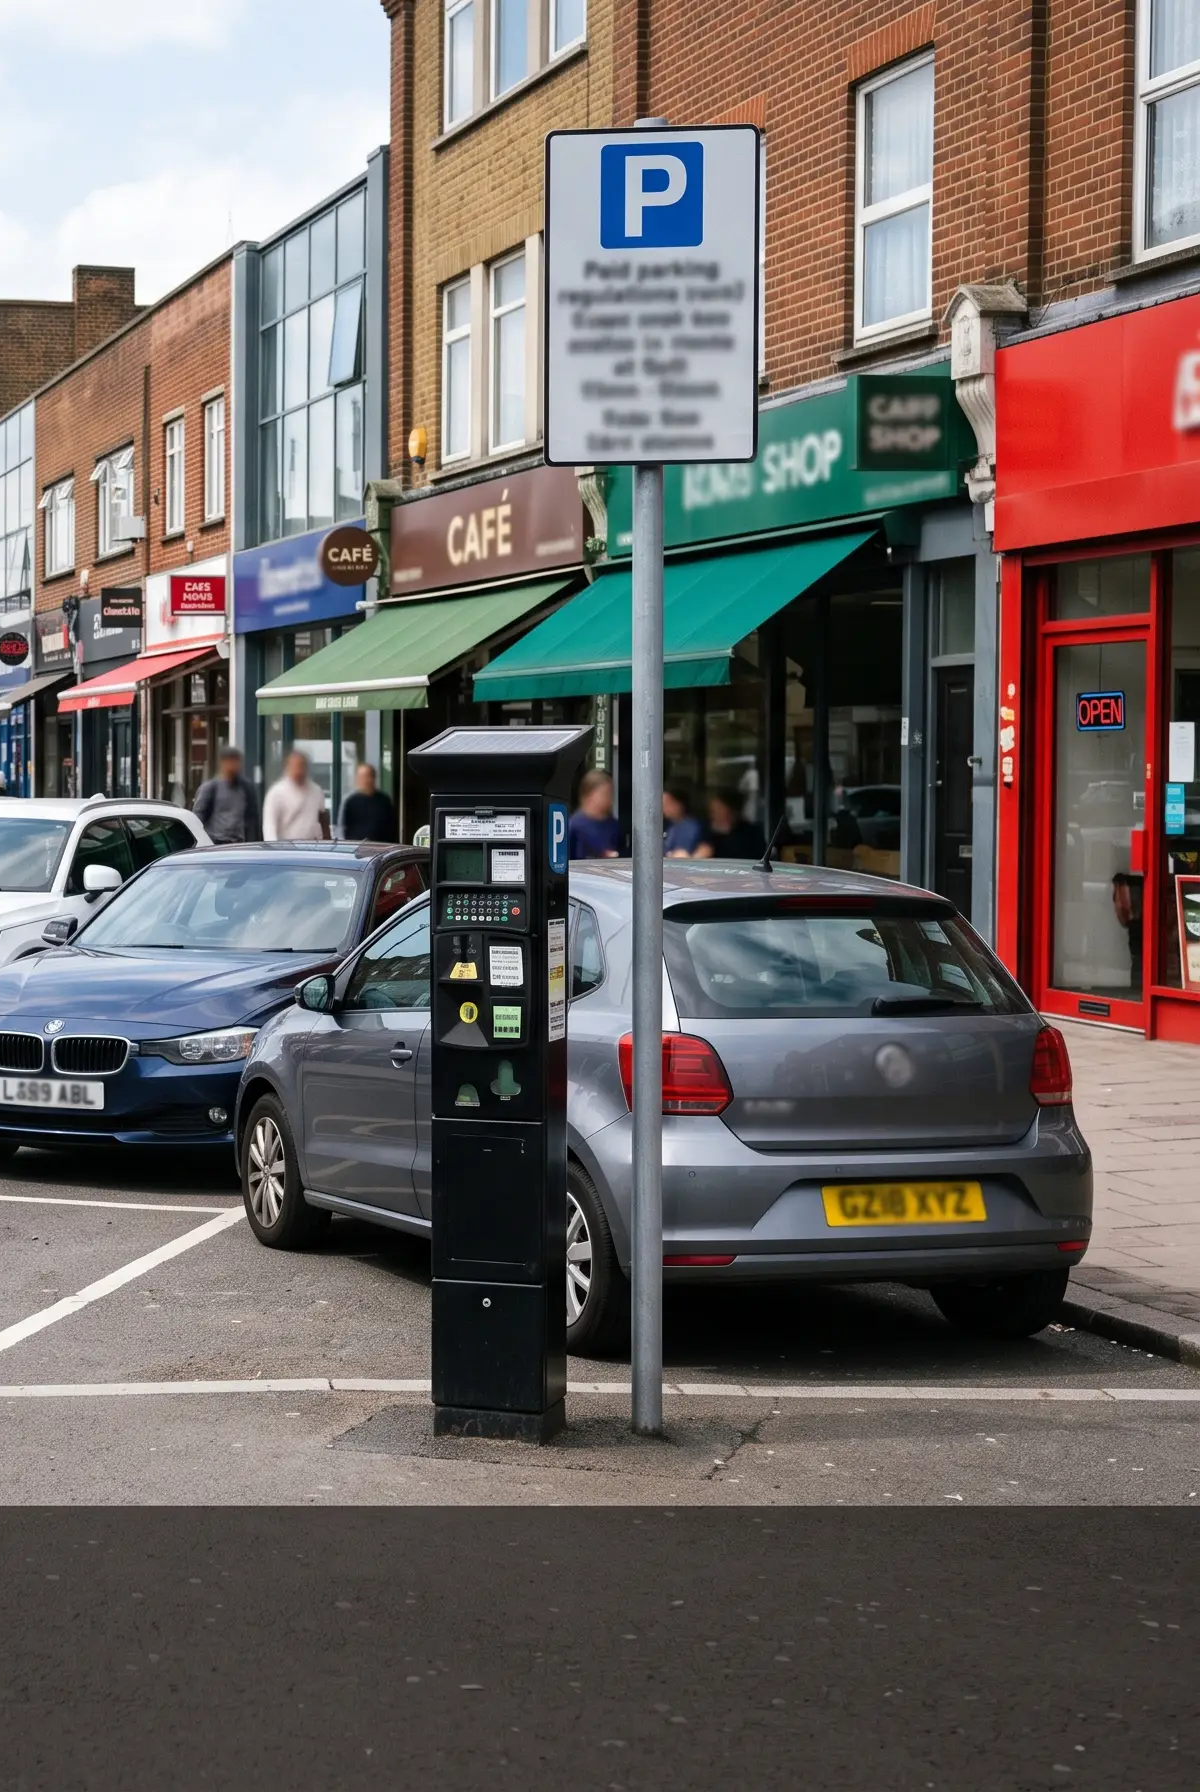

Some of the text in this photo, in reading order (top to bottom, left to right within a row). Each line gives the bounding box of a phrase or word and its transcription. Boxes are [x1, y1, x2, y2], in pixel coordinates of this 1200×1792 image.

[624, 154, 688, 238] P
[761, 428, 843, 495] SHOP
[327, 543, 373, 562] CAFÉ
[447, 487, 513, 567] CAFÉ
[1079, 698, 1122, 725] OPEN
[553, 811, 565, 863] P
